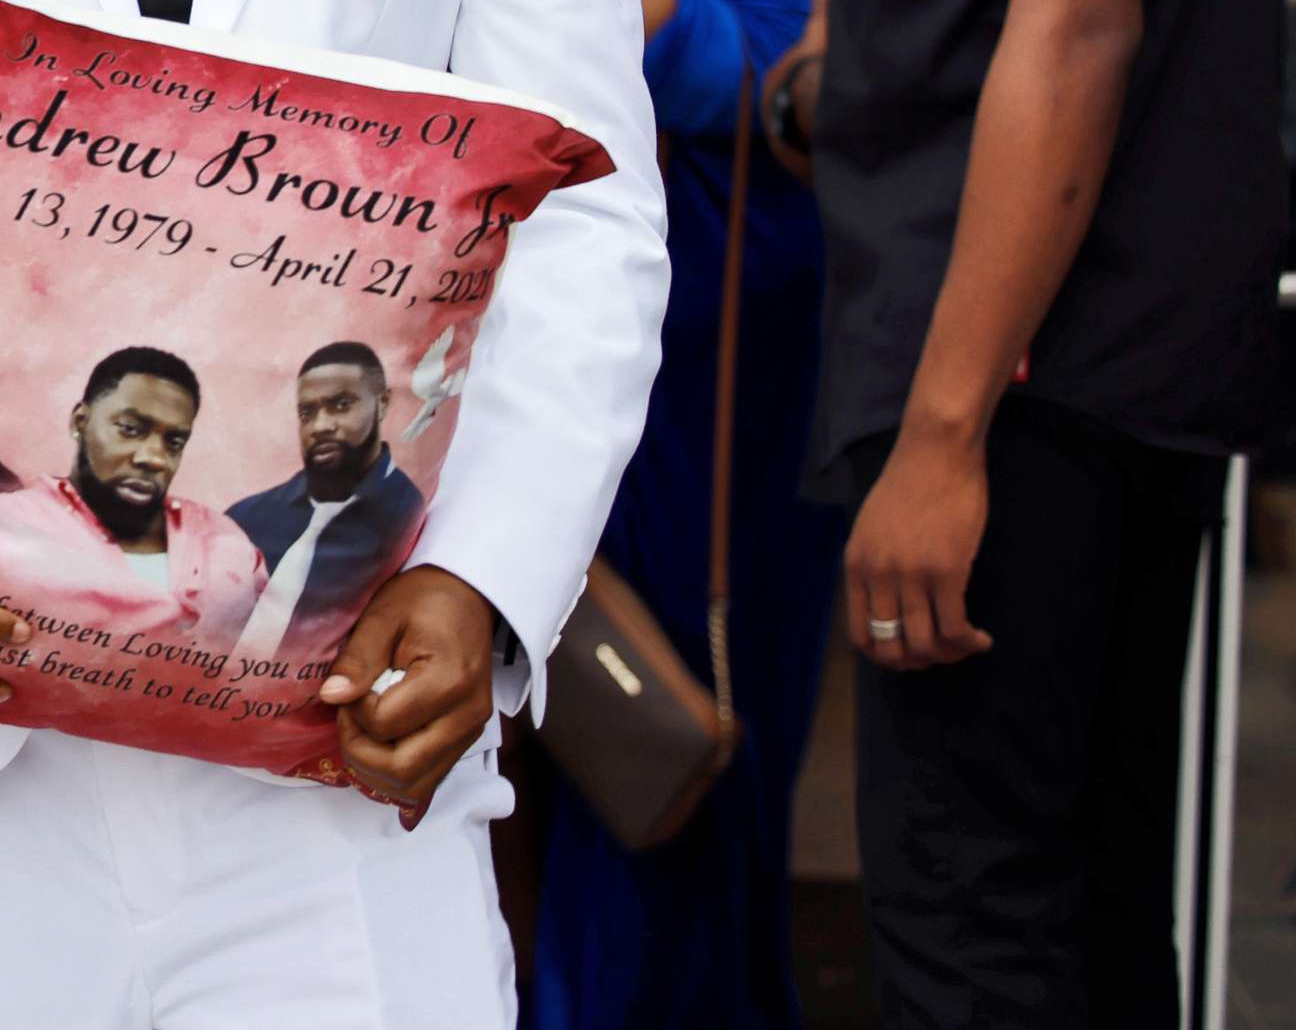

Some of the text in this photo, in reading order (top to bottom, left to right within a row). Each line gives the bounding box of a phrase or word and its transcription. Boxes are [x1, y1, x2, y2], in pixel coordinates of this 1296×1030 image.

[6, 31, 477, 160] In Loving Memory Of
[195, 129, 438, 233] Brown
[13, 187, 71, 241] 13,
[86, 202, 194, 256] 1979
[229, 234, 357, 287] April
[362, 258, 419, 309] 21,
[428, 266, 495, 304] 2021
[40, 650, 137, 692] breath
[142, 678, 174, 699] to
[182, 687, 242, 712] tell
[232, 703, 292, 722] you
[120, 632, 231, 681] Loving
[230, 657, 289, 683] you
[296, 658, 335, 682] an
